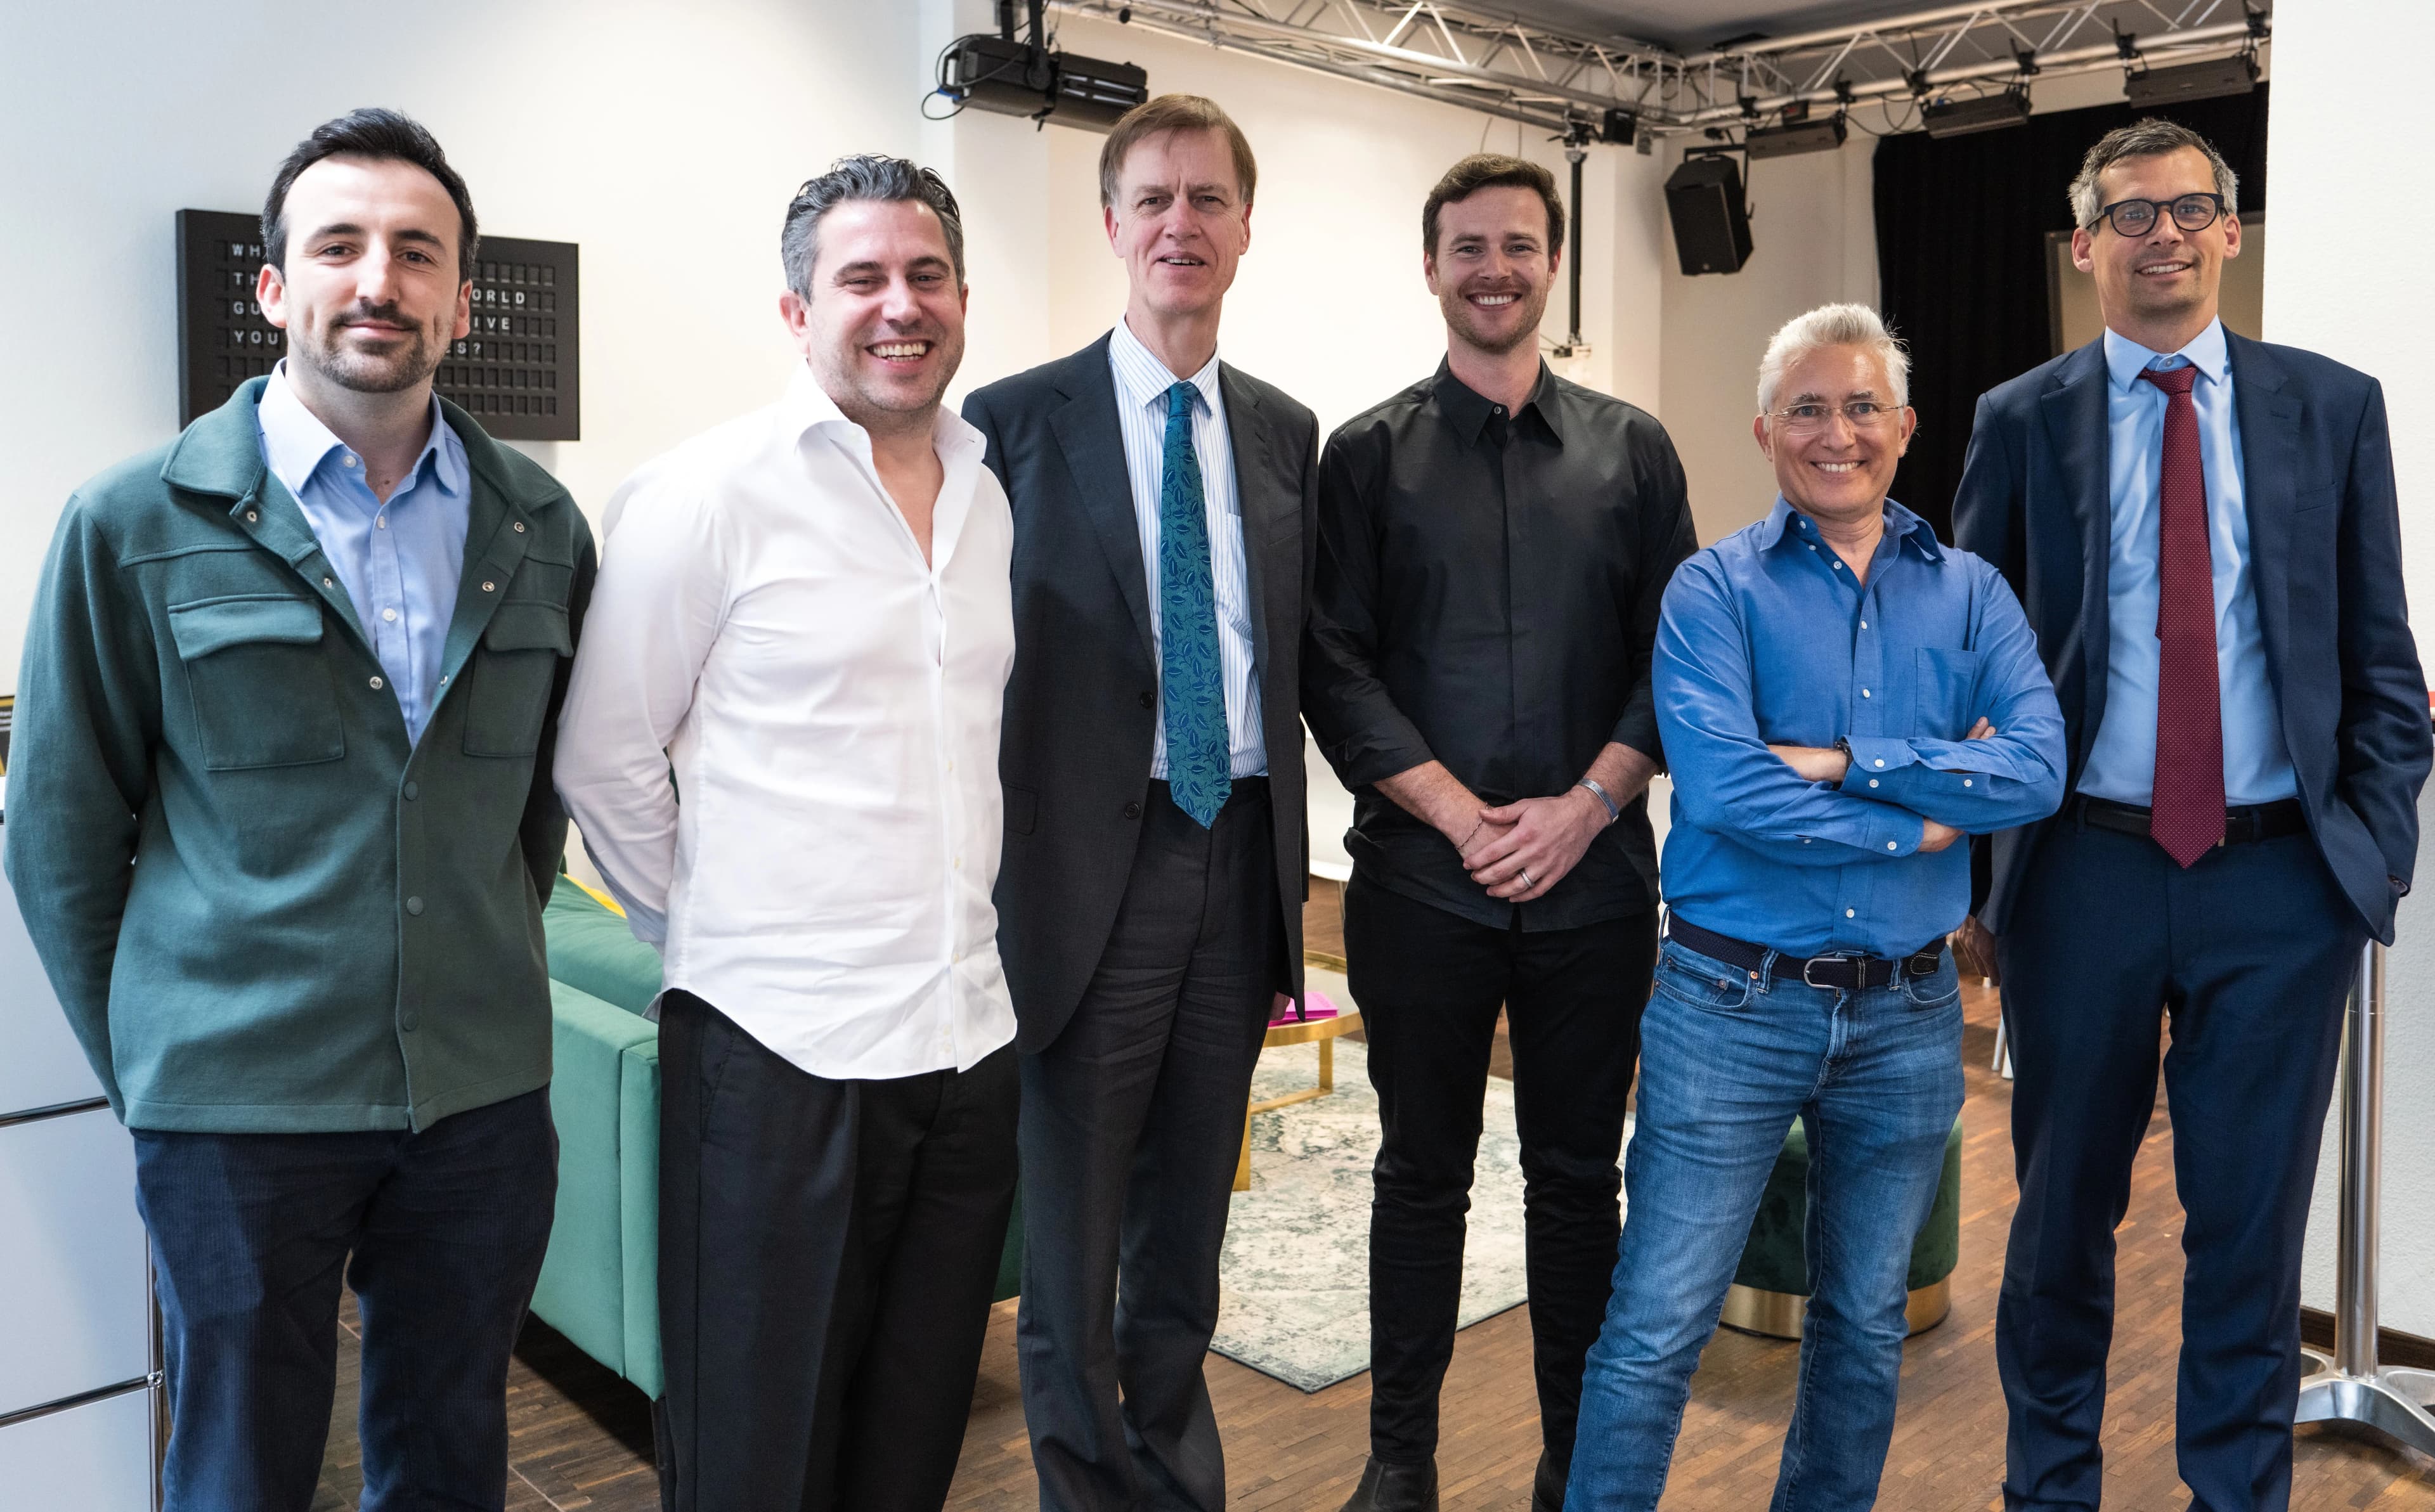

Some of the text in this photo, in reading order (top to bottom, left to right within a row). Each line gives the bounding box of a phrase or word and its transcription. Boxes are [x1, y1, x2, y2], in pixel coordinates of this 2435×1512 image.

[232, 243, 261, 257] WH
[233, 272, 525, 304] TH ORLD
[233, 301, 510, 330] GU IVE
[234, 330, 279, 345] YOU
